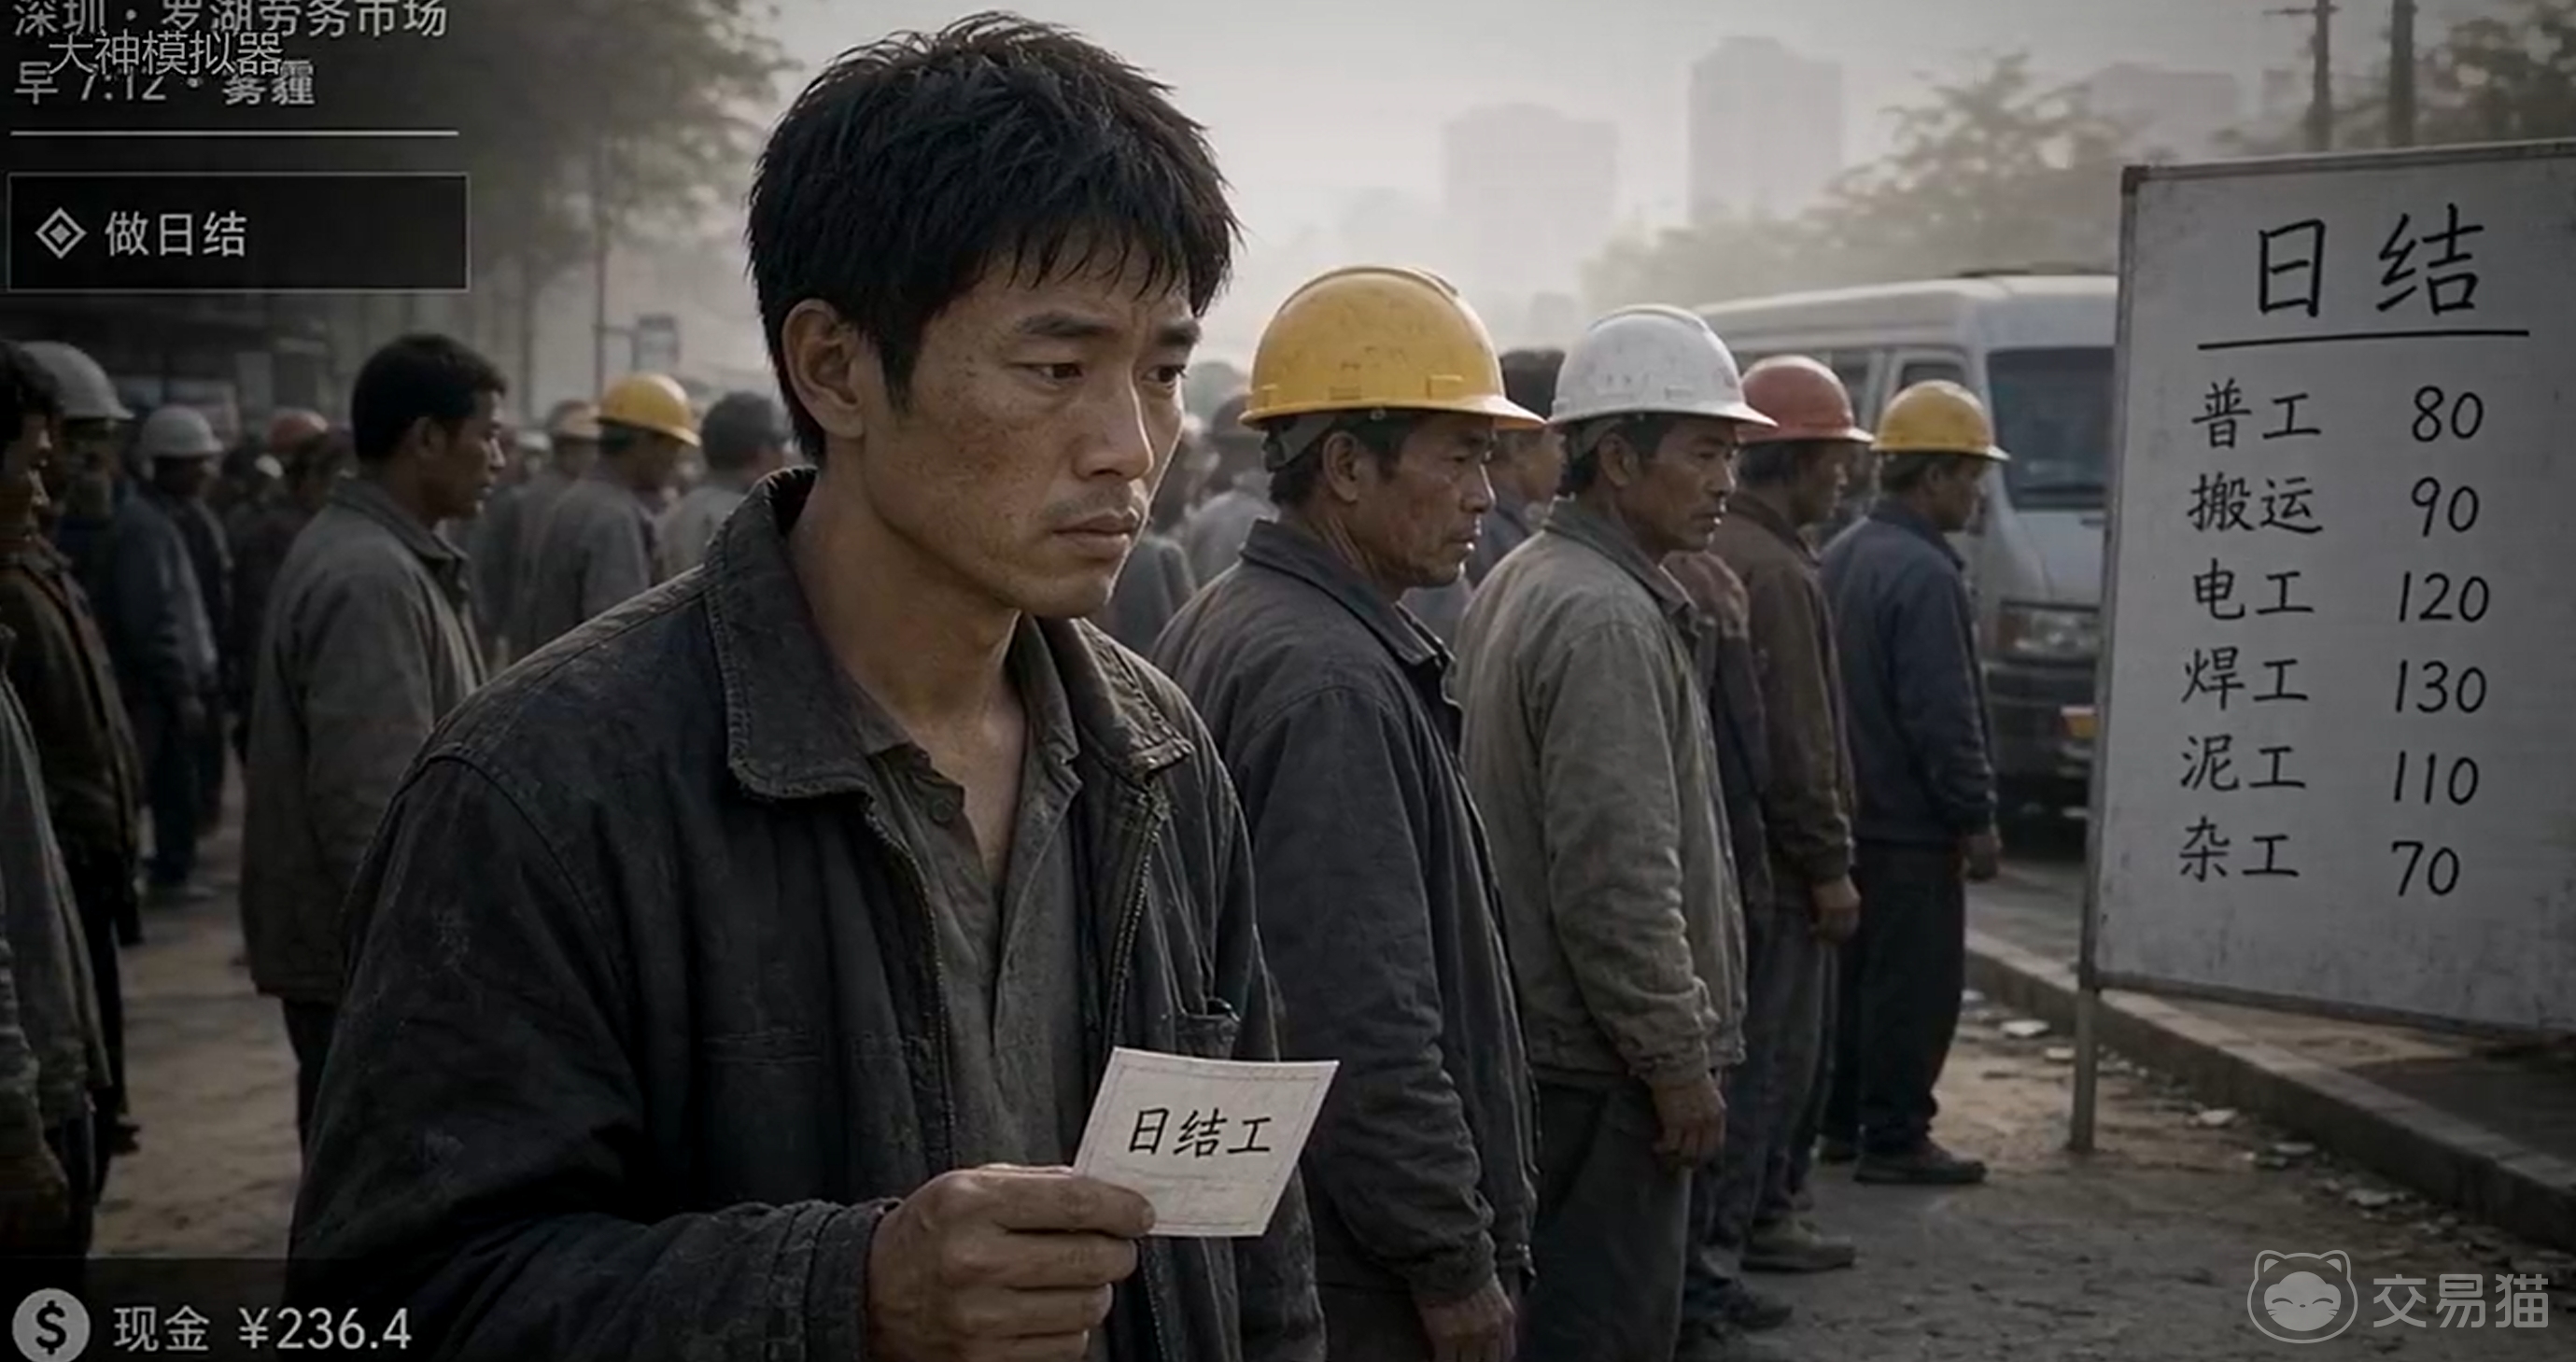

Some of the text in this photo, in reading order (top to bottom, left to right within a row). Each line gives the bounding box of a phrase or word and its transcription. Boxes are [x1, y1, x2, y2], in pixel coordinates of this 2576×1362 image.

[2258, 202, 2485, 318] 日结
[2192, 378, 2484, 448] 普工 80
[2188, 472, 2480, 538] 搬运 90
[2193, 558, 2490, 623] 电工 120
[2182, 646, 2487, 714] 焊工 130
[2180, 734, 2479, 806] 泥工 110
[2180, 816, 2460, 897] 杂工 70
[1129, 1107, 1272, 1158] 日结工
